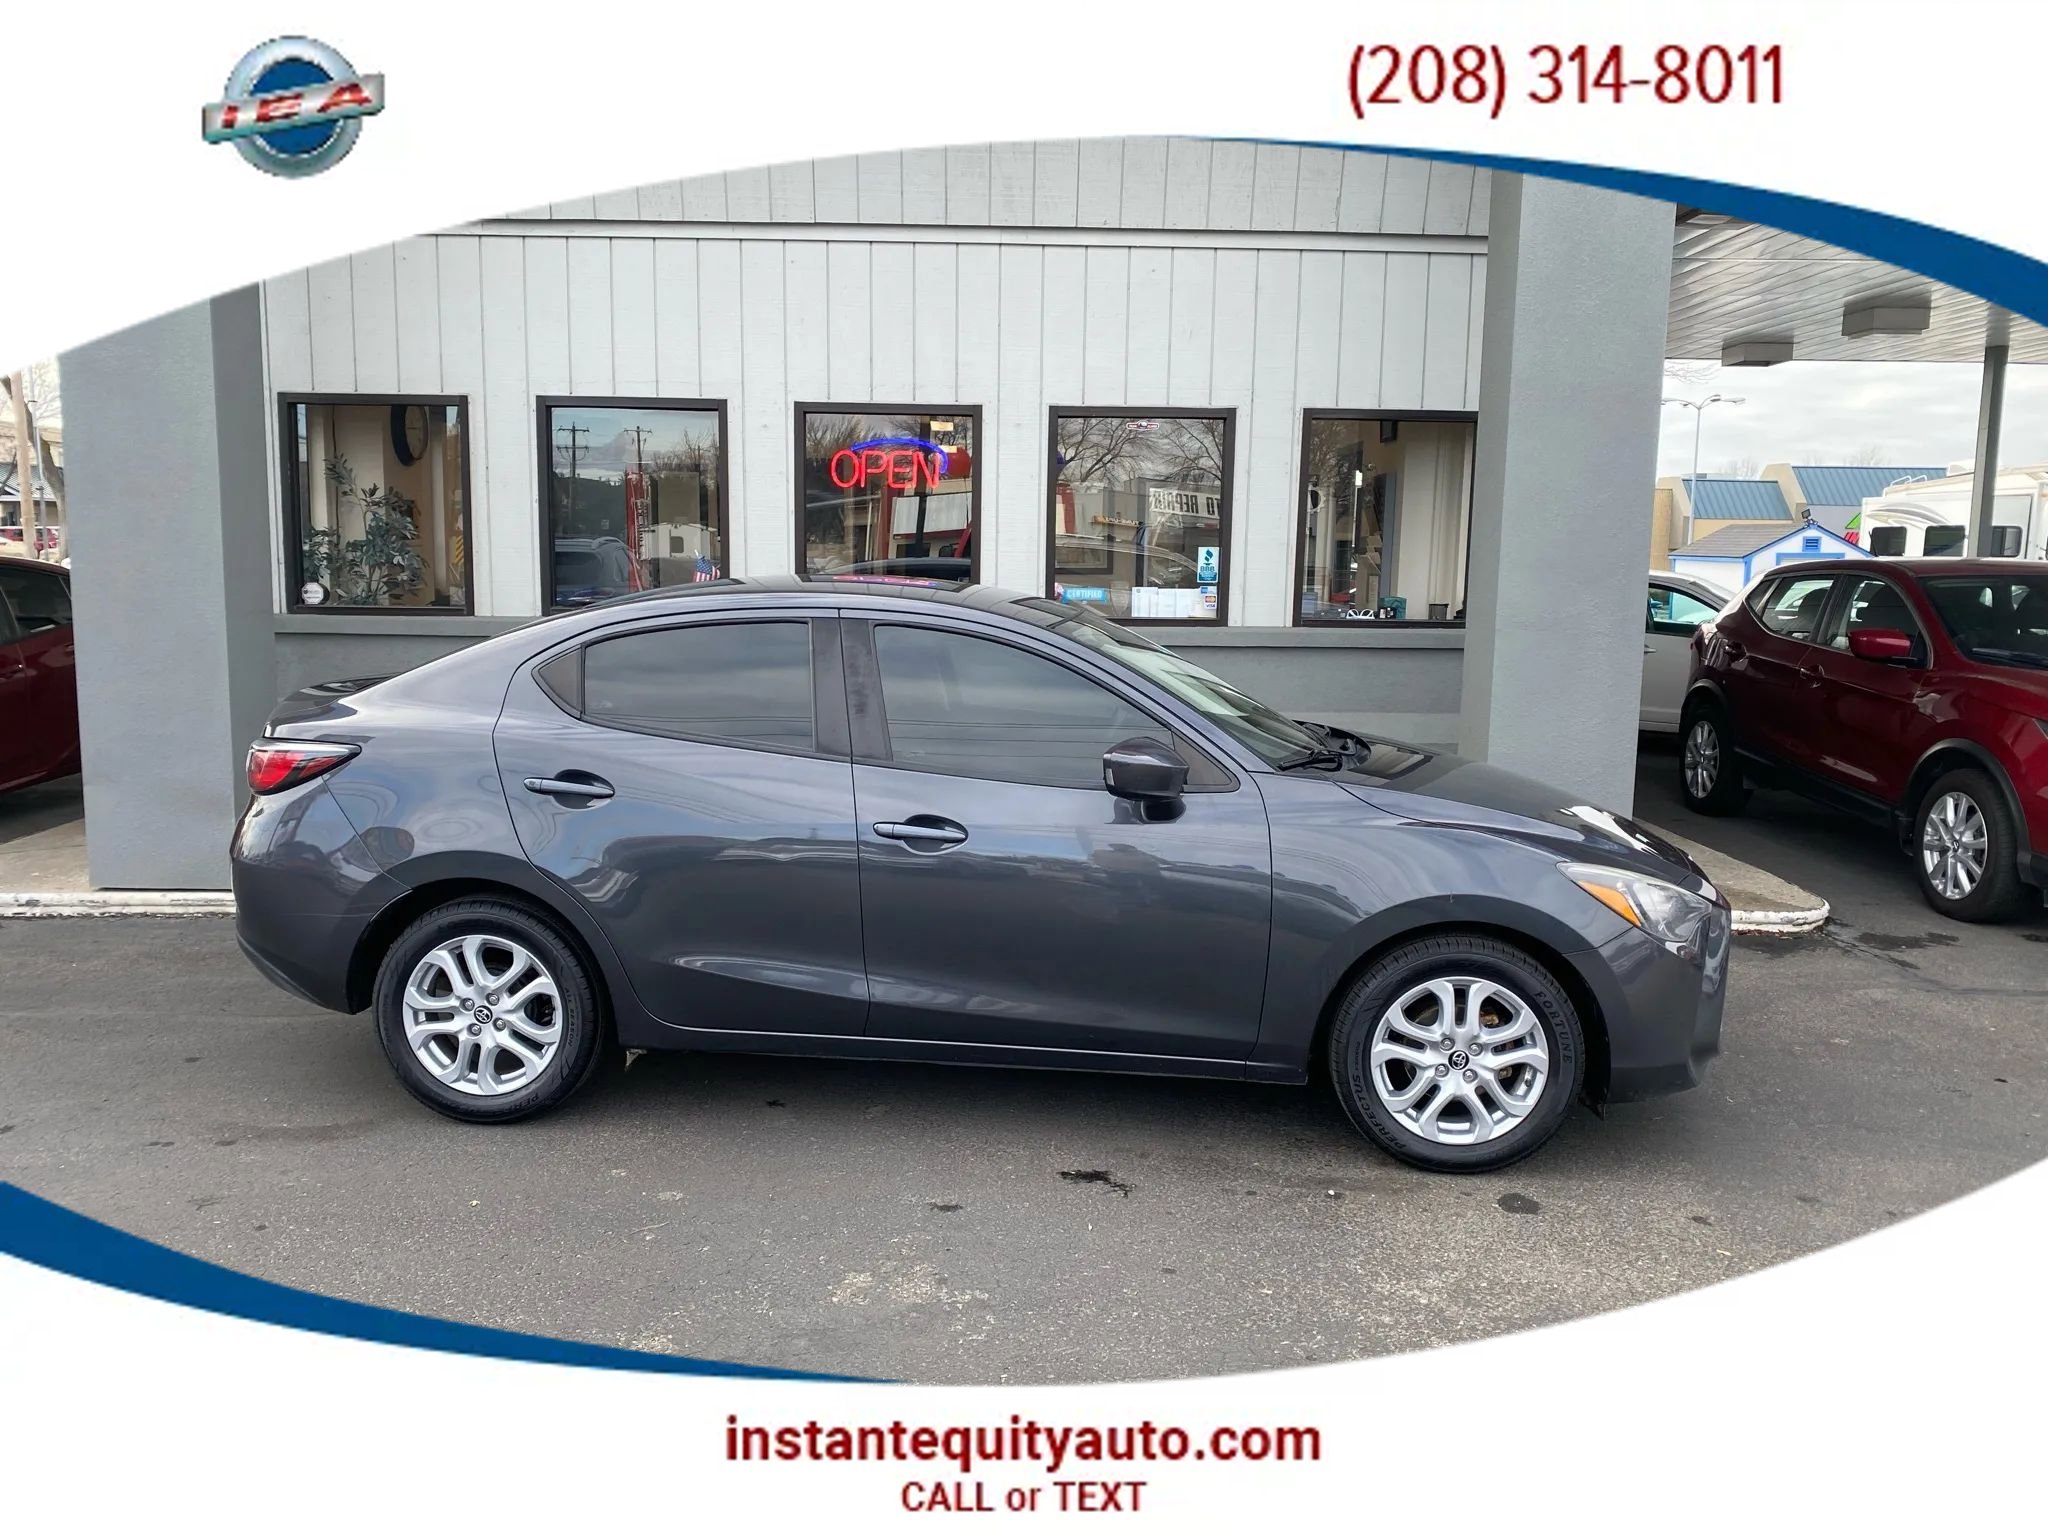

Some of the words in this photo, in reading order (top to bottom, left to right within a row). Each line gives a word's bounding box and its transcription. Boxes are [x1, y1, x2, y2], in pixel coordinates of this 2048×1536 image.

[831, 448, 941, 489] OPEN
[1534, 990, 1573, 1065] FORTUNE
[1351, 1072, 1407, 1150] PERFECTUS
